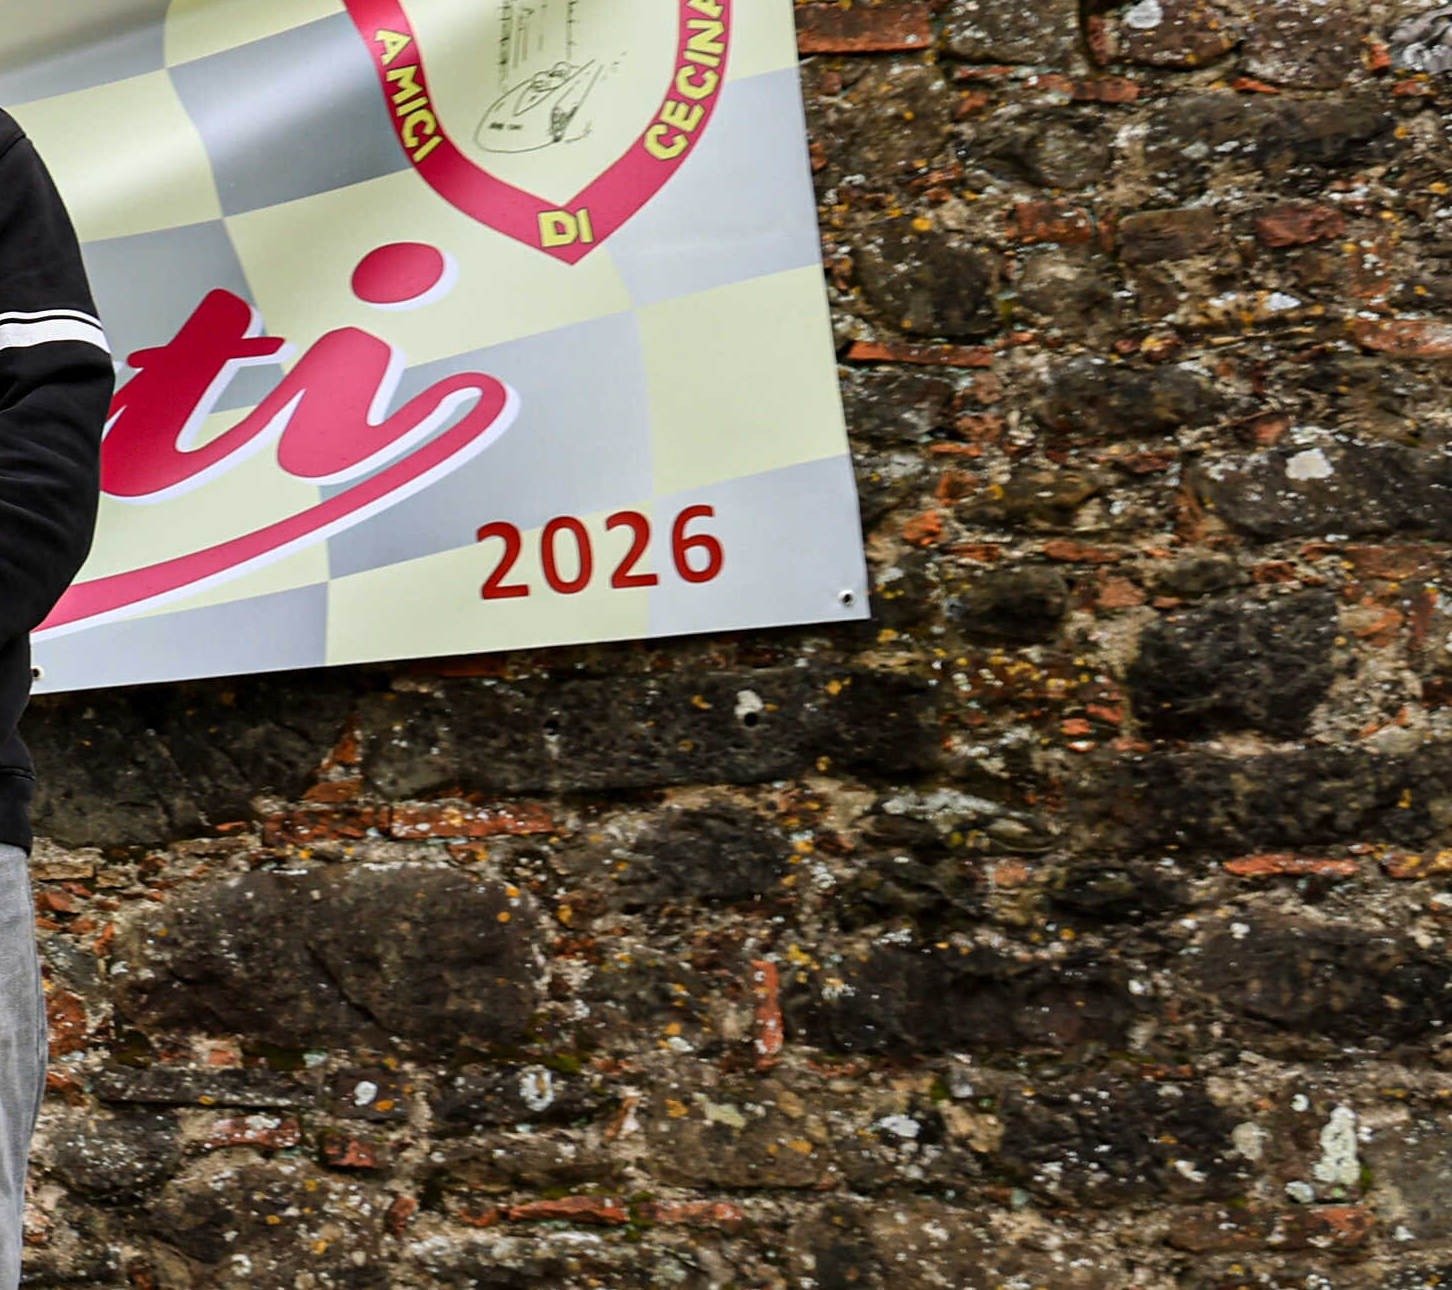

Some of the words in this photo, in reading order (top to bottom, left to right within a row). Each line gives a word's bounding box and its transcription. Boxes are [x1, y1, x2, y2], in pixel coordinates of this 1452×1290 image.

[375, 28, 443, 162] AMICI
[538, 207, 596, 248] DI
[476, 504, 724, 600] 2026
